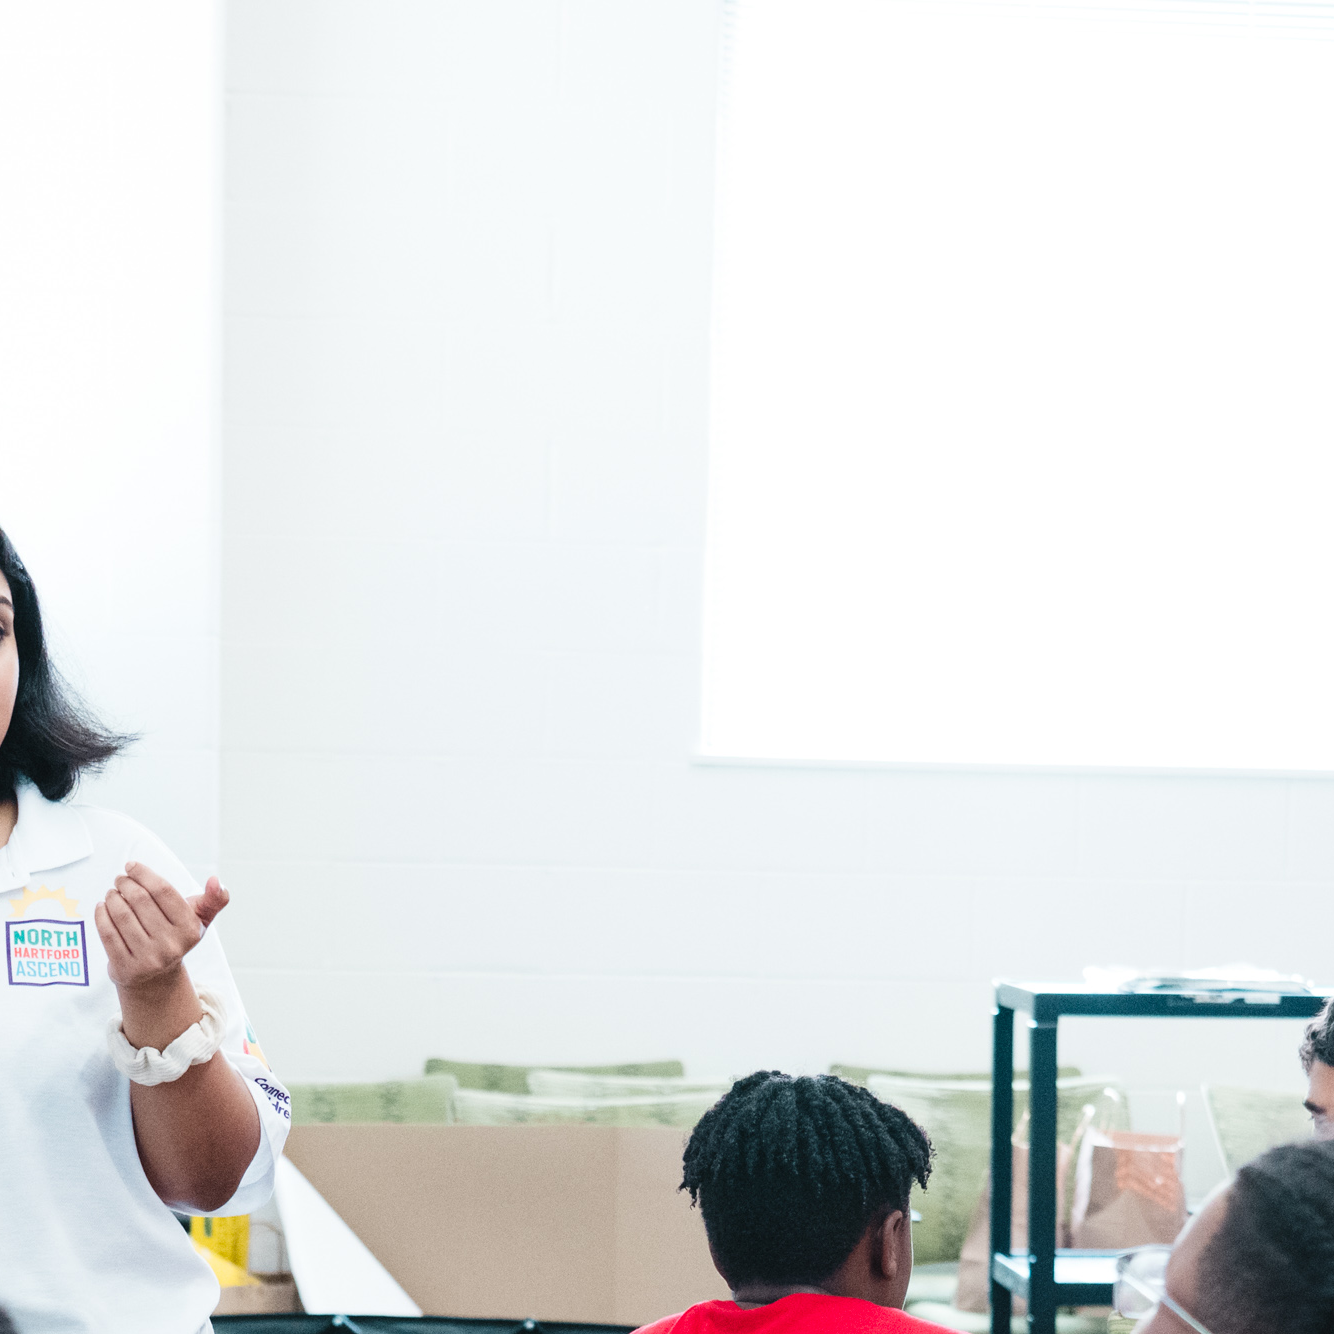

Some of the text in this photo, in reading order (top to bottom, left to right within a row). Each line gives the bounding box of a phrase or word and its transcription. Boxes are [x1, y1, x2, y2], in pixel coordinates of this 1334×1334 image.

[13, 928, 78, 947] NORTH
[14, 947, 79, 960] HARTFORD
[16, 960, 80, 978] ASCEND
[254, 1077, 290, 1104] Connec
